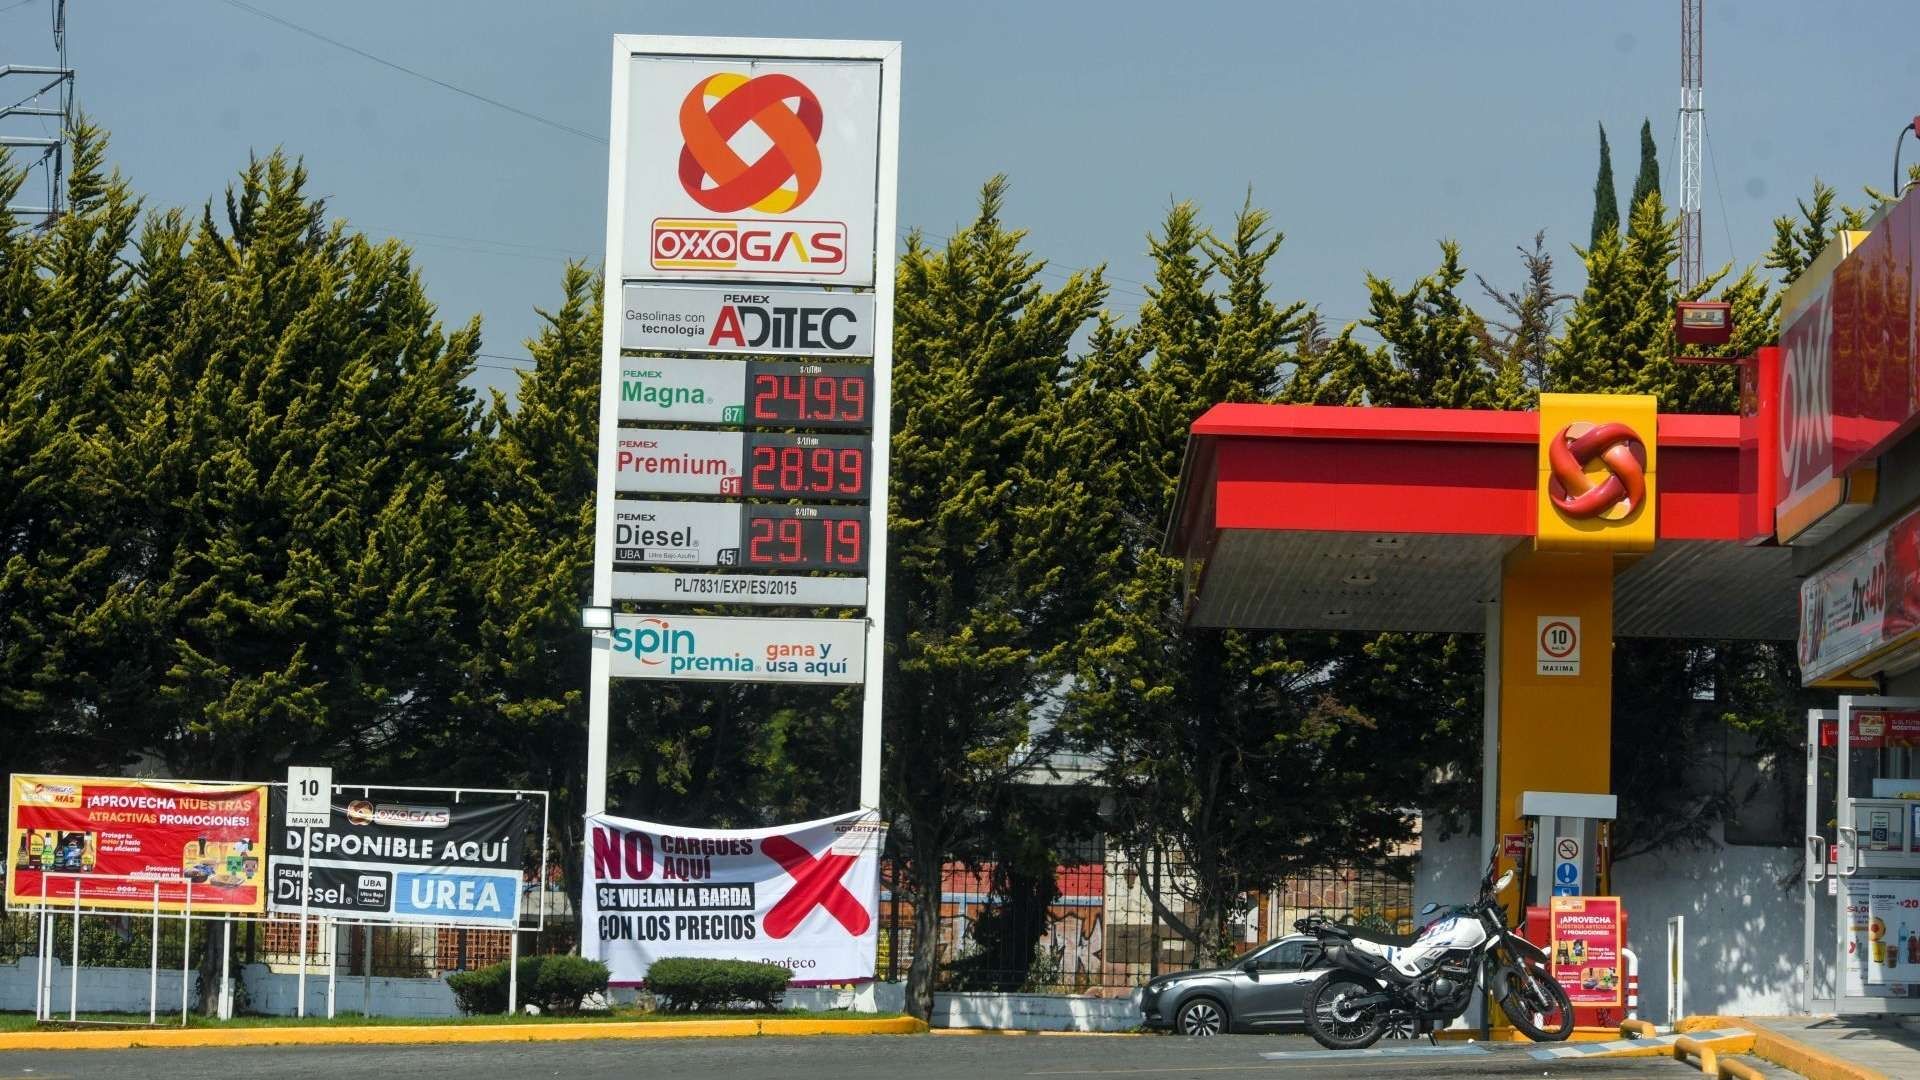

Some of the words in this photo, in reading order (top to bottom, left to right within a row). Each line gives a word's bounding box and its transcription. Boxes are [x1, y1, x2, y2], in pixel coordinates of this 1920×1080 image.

[723, 294, 770, 304] PEMEX
[625, 310, 682, 322] Gasolinas
[684, 313, 706, 323] con
[642, 324, 705, 336] tecnología
[623, 370, 662, 378] PEMEX
[622, 381, 705, 408] Magna
[755, 375, 864, 420] 24.99
[724, 407, 739, 422] 87
[619, 440, 657, 448] PEMEX
[618, 452, 727, 475] Premium
[752, 447, 861, 492] 28.99
[722, 478, 738, 494] 91
[617, 513, 656, 521] PEMEX
[616, 524, 691, 547] Diesel
[751, 518, 860, 564] 29.19
[620, 549, 640, 559] UBA
[719, 550, 733, 565] 45
[674, 578, 797, 595] PL/7831/EXP/ES/2015
[612, 621, 695, 660] spin
[1551, 630, 1567, 645] 10
[766, 644, 815, 661] gana
[819, 643, 832, 658] y
[671, 652, 754, 674] premia
[766, 660, 798, 673] usa
[805, 658, 847, 674] aquí
[300, 779, 319, 796] 10
[87, 796, 176, 809] ¡APROVECHA
[179, 798, 252, 812] NUESTRAS
[88, 812, 157, 824] ATRACTIVAS
[159, 814, 250, 828] PROMOCIONES!
[286, 831, 433, 859] DSPONIBLE
[441, 836, 509, 862] AQUÍ
[592, 827, 654, 881] NO
[660, 835, 754, 856] CARGUES
[663, 855, 711, 882] AQUÍ
[363, 879, 382, 888] UBA
[411, 879, 501, 913] UREA
[600, 887, 617, 907] SE
[618, 887, 675, 907] VUELAN
[678, 887, 695, 907] LA
[701, 887, 751, 907] BARDA
[599, 915, 632, 940] CON
[637, 915, 671, 940] LOS
[675, 914, 756, 940] PRECIOS
